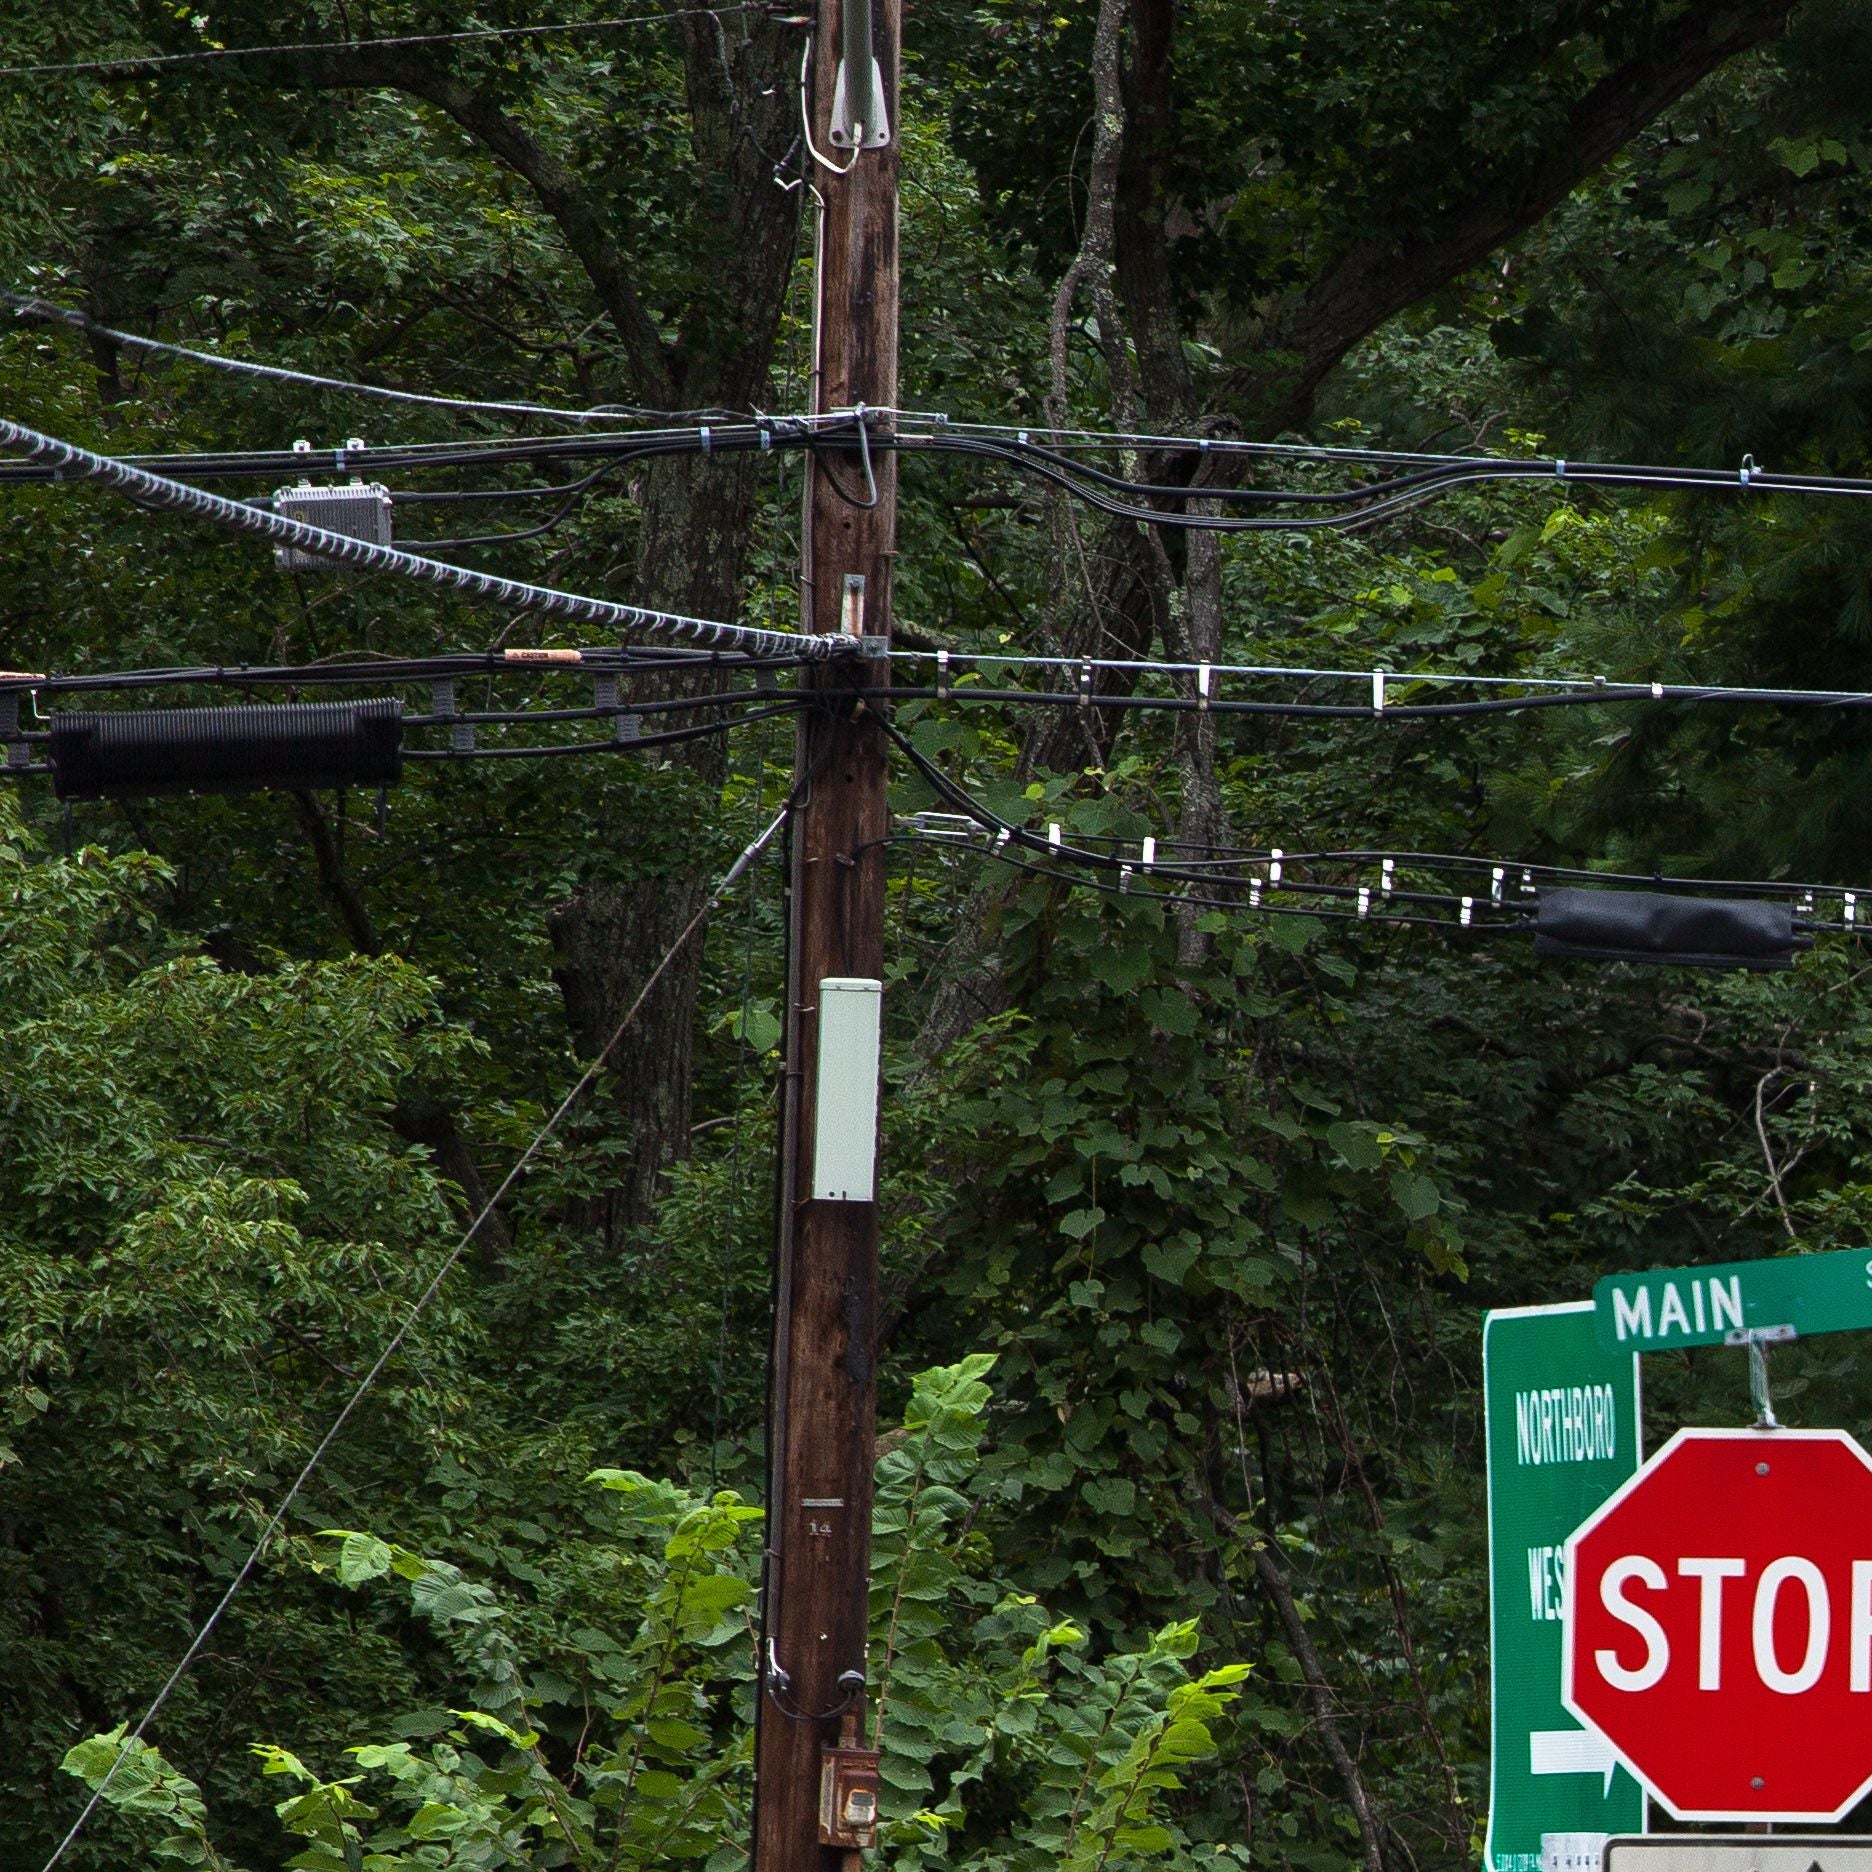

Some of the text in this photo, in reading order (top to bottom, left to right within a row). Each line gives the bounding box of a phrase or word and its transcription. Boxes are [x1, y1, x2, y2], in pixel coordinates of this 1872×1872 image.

[1612, 1274, 1744, 1341] MAIN
[1516, 1383, 1615, 1465] NORTHBORO
[809, 1520, 832, 1538] 14
